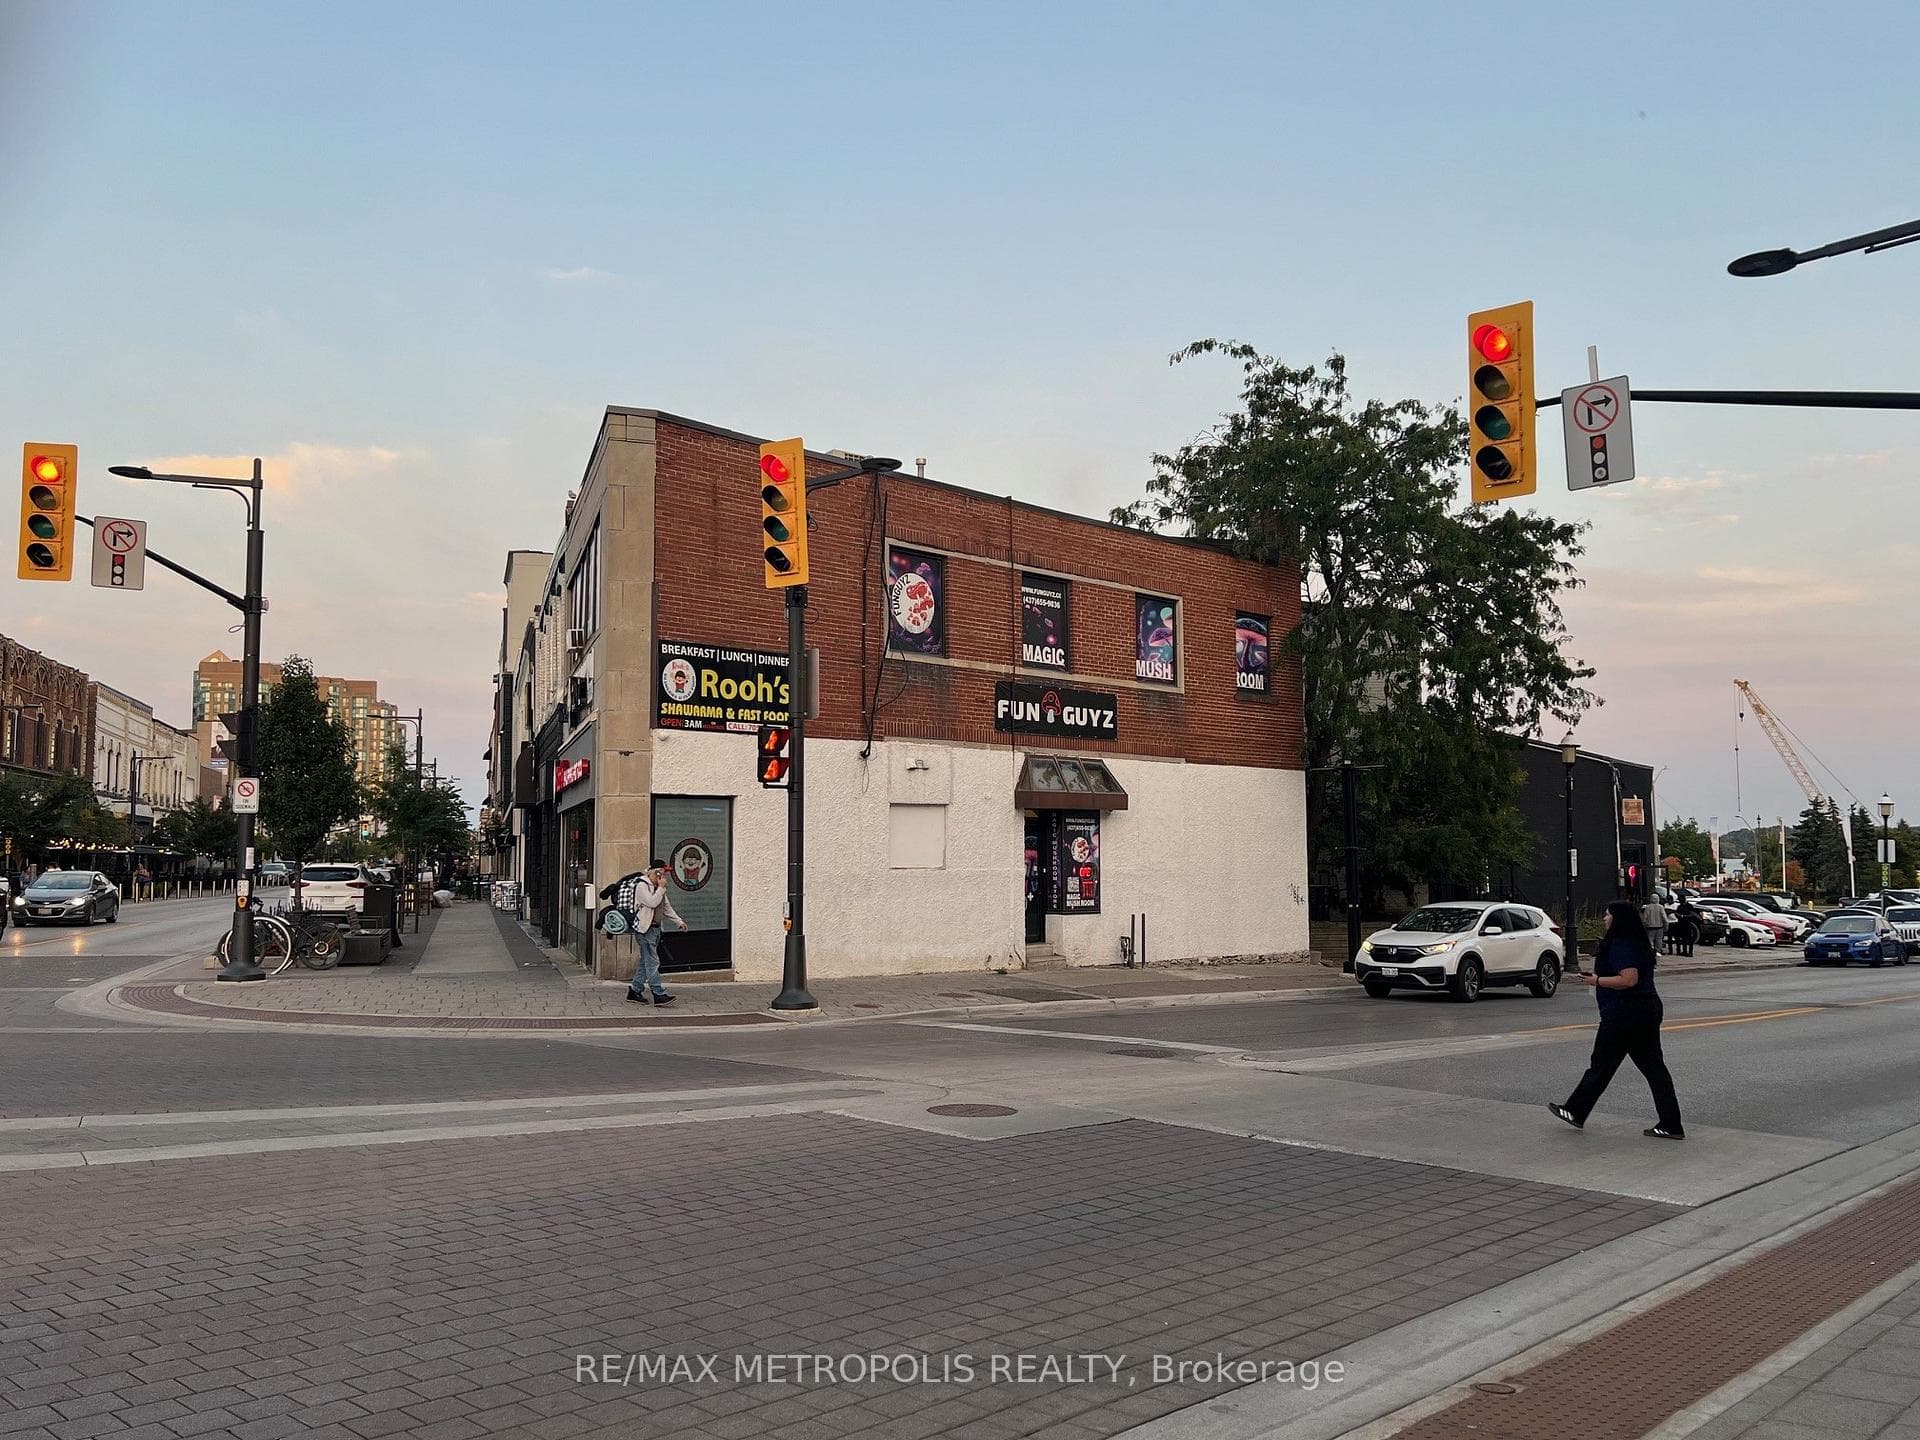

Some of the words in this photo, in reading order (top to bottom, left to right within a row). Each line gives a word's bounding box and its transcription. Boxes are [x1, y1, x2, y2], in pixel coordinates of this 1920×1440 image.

[892, 574, 911, 617] FUNGUYZ
[661, 643, 715, 659] BREAKFAST
[721, 650, 753, 663] LUNCH
[1022, 644, 1065, 667] MAGIC
[1136, 660, 1174, 681] MUSH
[701, 669, 790, 704] Rooh's
[661, 702, 723, 719] SHAWARMA
[726, 708, 735, 720] &
[738, 709, 762, 720] FAST
[997, 699, 1040, 722] FUN
[1062, 706, 1114, 729] GUYZ
[684, 719, 702, 729] 3AM
